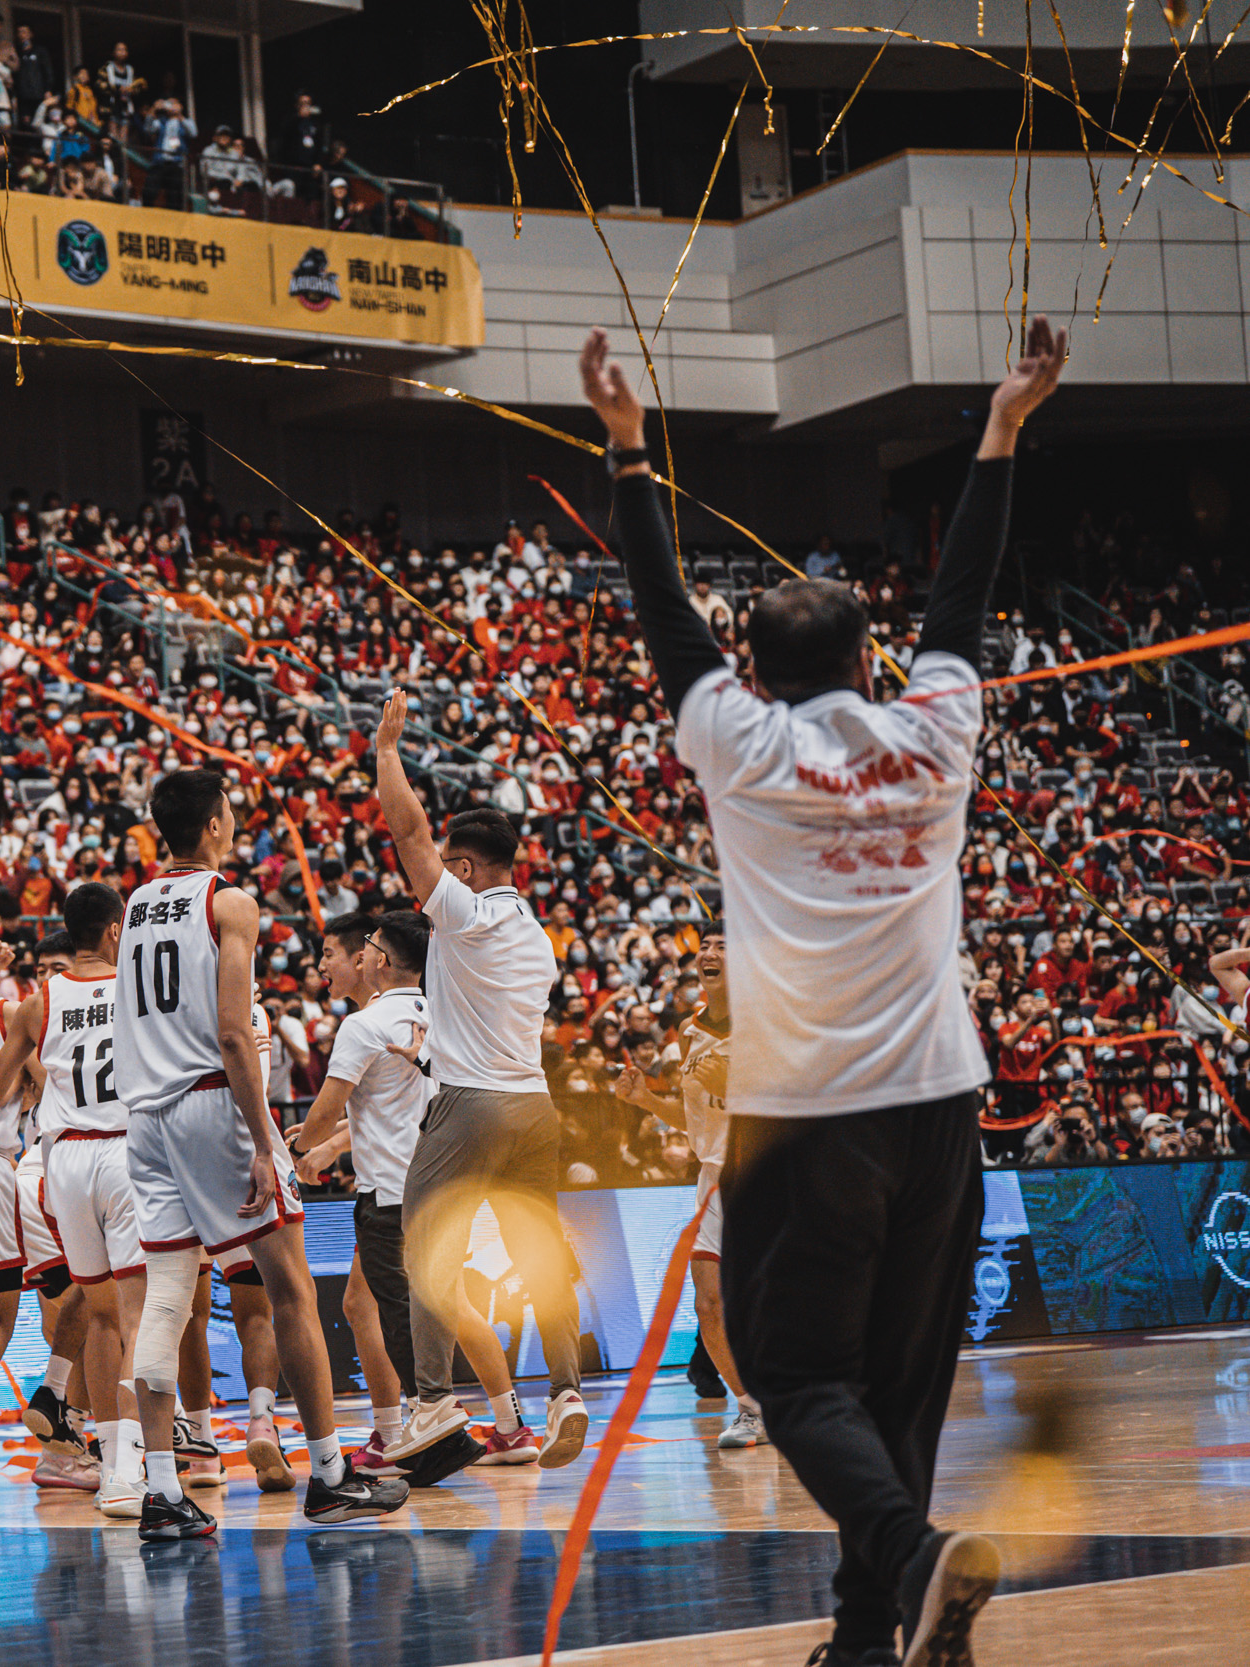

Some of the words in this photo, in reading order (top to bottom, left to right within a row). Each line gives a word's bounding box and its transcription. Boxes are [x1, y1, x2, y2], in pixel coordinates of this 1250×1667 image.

[117, 231, 226, 268] 陽明高中
[120, 272, 209, 295] YANG-MING
[348, 258, 448, 292] 南山高中
[132, 939, 180, 1018] 10
[62, 1003, 115, 1033] 陳相
[71, 1037, 119, 1109] 12
